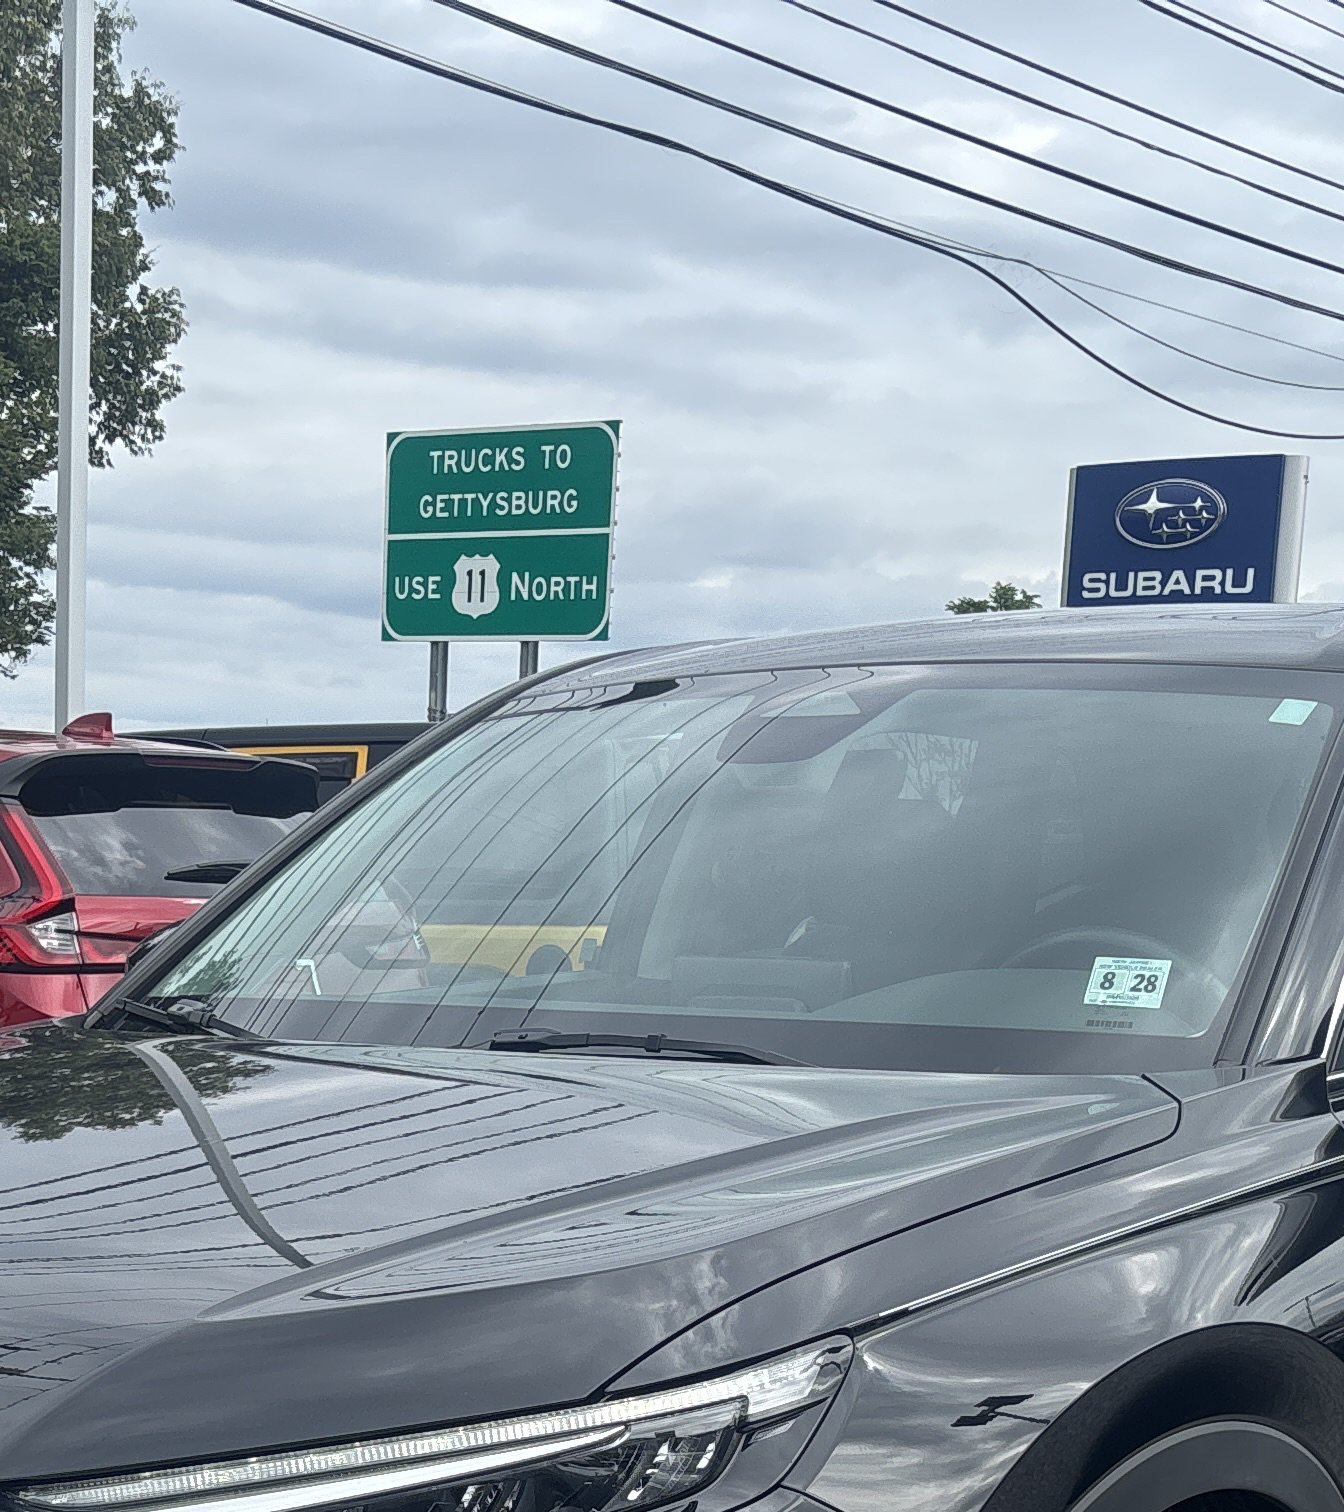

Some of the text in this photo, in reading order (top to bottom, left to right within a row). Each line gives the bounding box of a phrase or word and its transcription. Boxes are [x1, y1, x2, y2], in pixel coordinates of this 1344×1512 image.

[429, 444, 572, 474] TRUCKS TO
[419, 489, 578, 518] GETTYSBURG
[394, 568, 598, 603] USE 11 NORTH
[1081, 567, 1255, 599] SUBARU
[1100, 972, 1159, 993] 8 28
